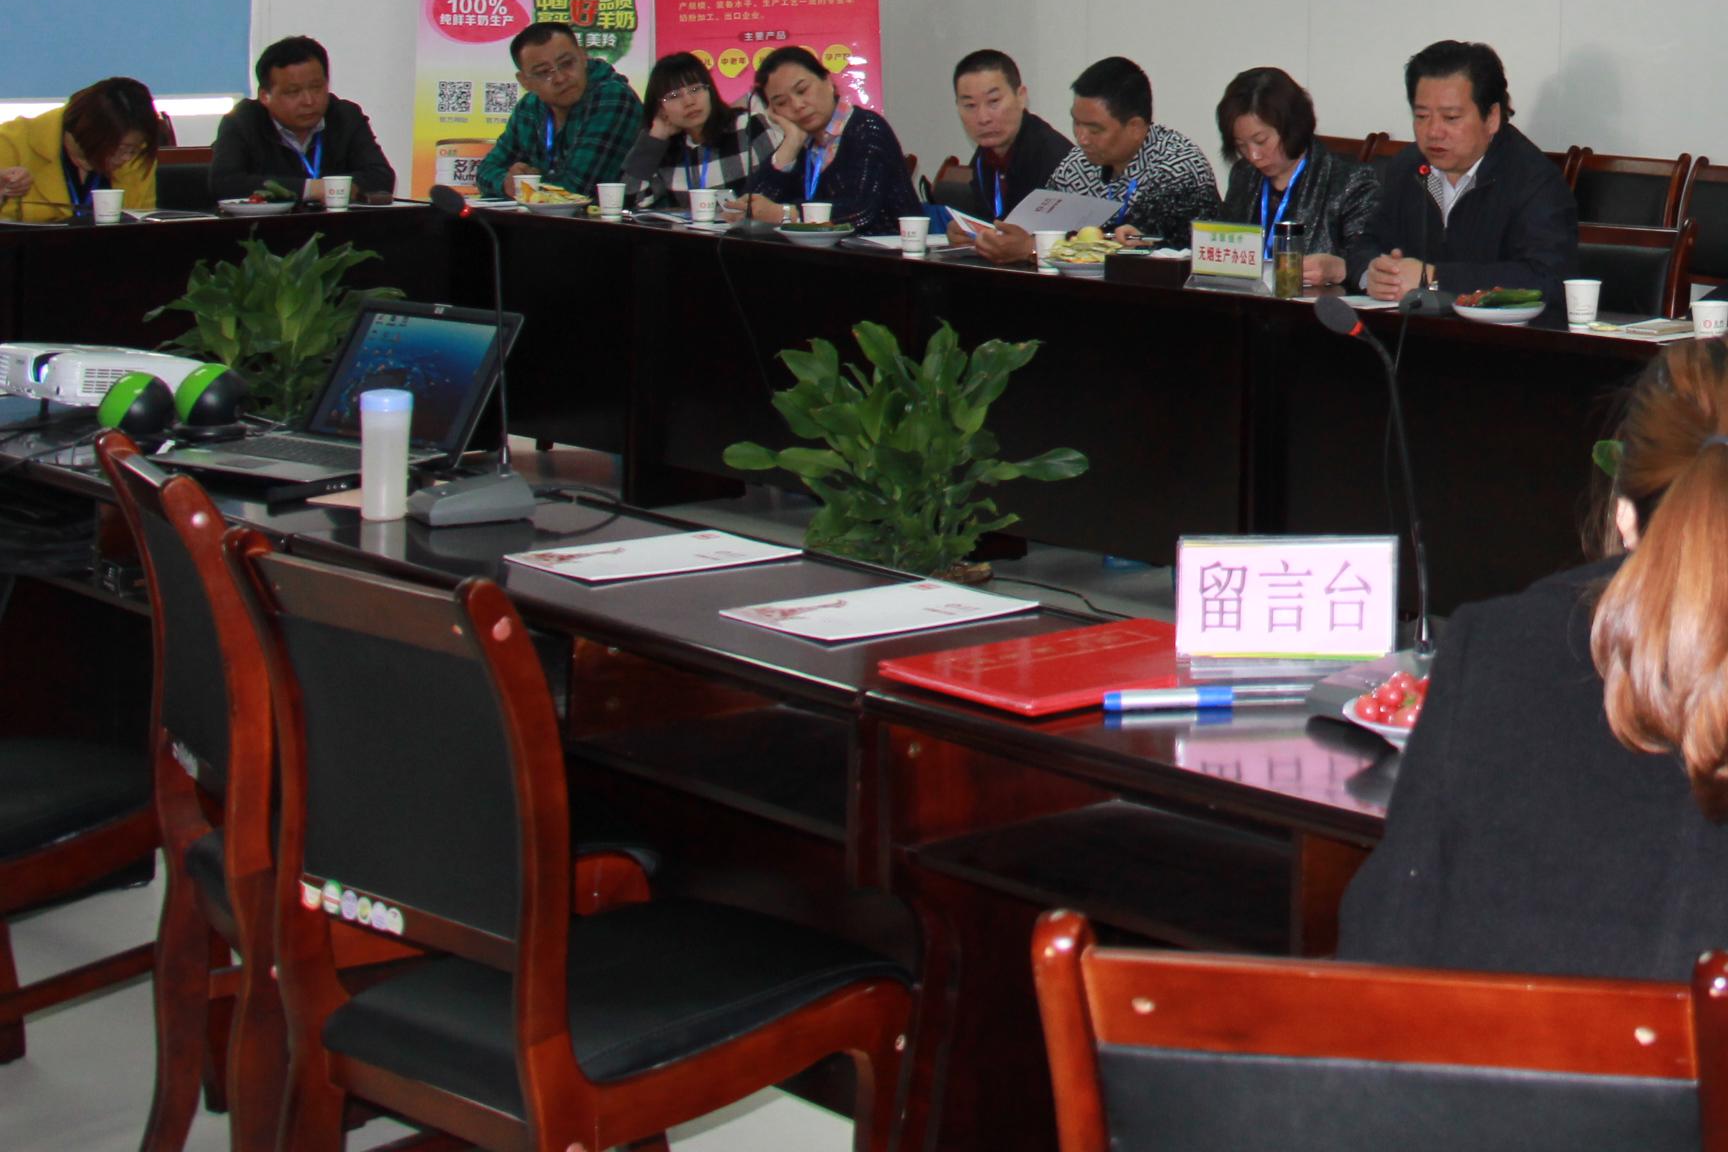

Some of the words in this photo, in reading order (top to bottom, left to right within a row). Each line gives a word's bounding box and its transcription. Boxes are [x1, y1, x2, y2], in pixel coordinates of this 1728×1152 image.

[440, 14, 514, 26] 纯鲜羊奶生产
[597, 11, 635, 30] 羊奶
[744, 31, 786, 41] 主要产品
[1199, 246, 1256, 266] 无烟生产办公区
[1199, 559, 1371, 633] 留言台
